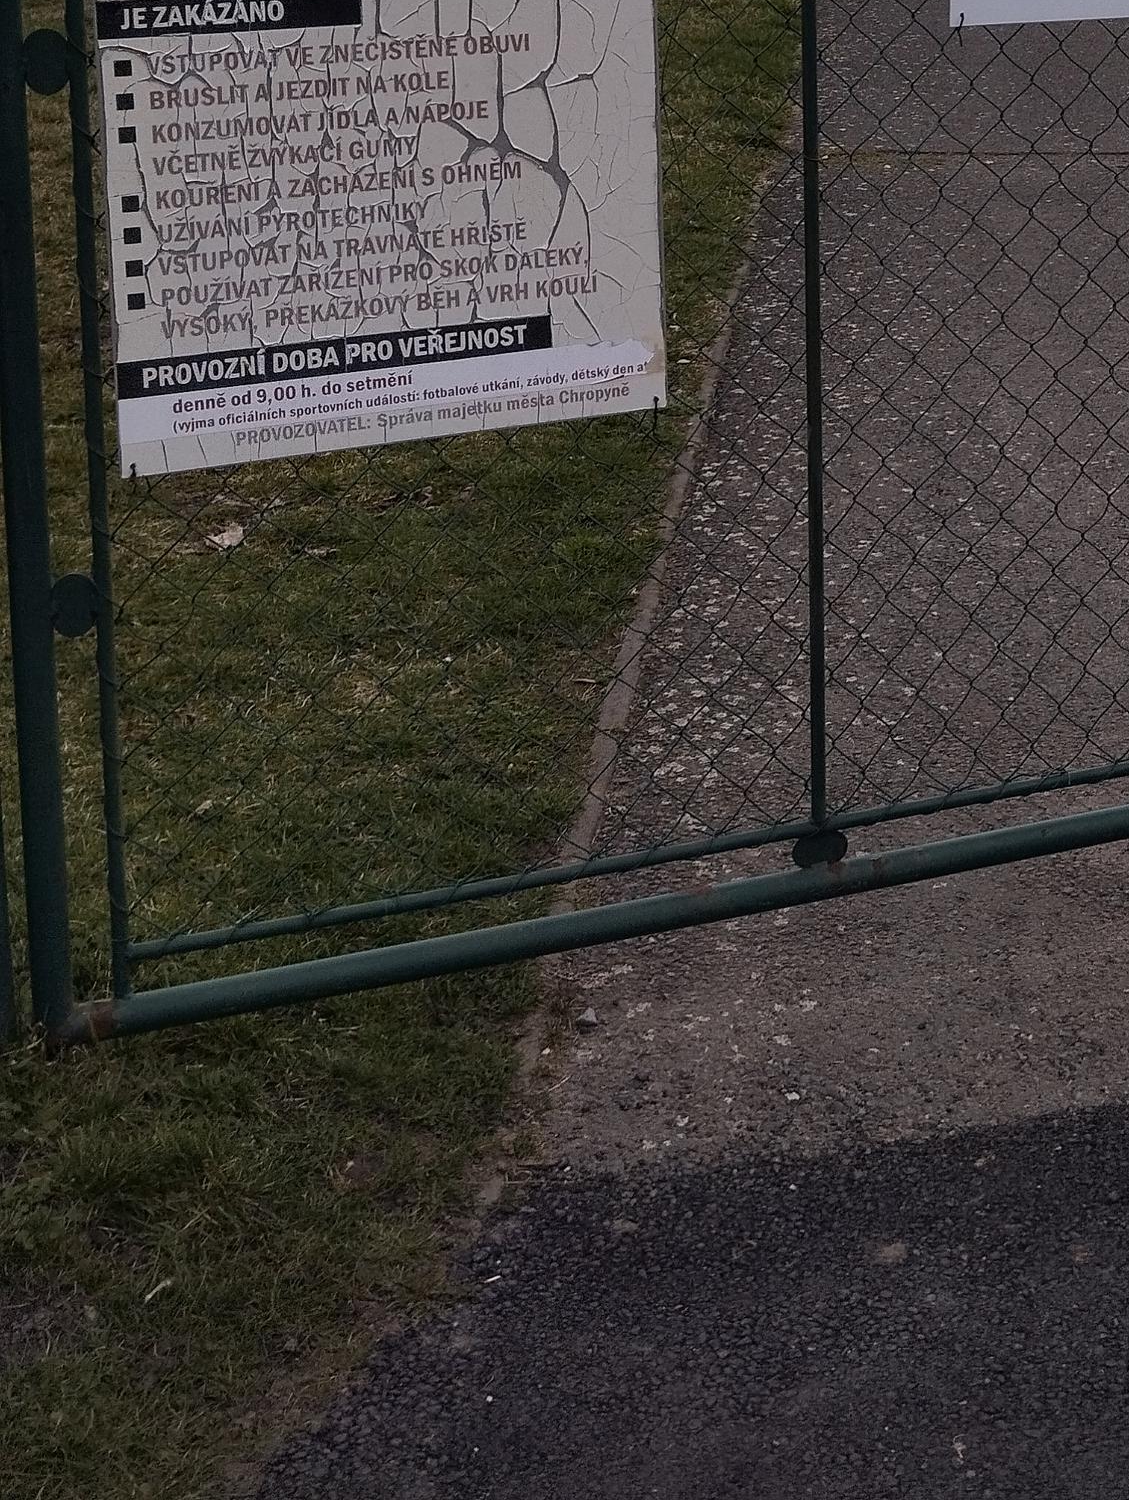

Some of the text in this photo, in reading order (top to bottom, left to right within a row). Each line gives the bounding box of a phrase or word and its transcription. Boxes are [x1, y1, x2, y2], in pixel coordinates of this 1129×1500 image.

[121, 7, 147, 30] JE
[149, 33, 530, 75] VSTUPOVAT VE ZNEČIŠTĚNÉ OBUVI
[150, 71, 449, 110] BRUSLIT A JEZDIT NA KOLE
[152, 113, 312, 144] KONZUMOVAT
[385, 107, 399, 125] A
[407, 99, 489, 125] NÁPOJE
[152, 136, 416, 176] VČETNĚ ŽVÝKACÍ GUMY
[267, 181, 282, 199] A
[421, 168, 434, 186] S
[441, 158, 522, 185] OHNĚM
[157, 201, 429, 244] UŽÍVÁNÍ PYROTECHNIKY
[158, 216, 527, 276] VSTUPOVAT NA TRAVNATÉ HŘIŠTĚ
[162, 241, 588, 306] POUŽÍVAT ZAŘÍZENÍ PRO SKOK DALEKÝ,
[161, 306, 257, 340] VYSOKÝ,
[416, 287, 459, 311] BĚH
[466, 288, 481, 305] A
[487, 283, 528, 303] VRH
[536, 269, 597, 298] KOULÍ
[142, 324, 527, 389] PROVOZNÍ DOBA PRO VEŘEJNOST
[172, 369, 412, 413] denně od 9,00 h. do setmění
[173, 416, 215, 434] (vyjma
[219, 408, 286, 426] oficiálních
[290, 398, 363, 421] sportovních
[366, 389, 420, 409] událostí:
[423, 382, 479, 400] fotbalové
[482, 377, 524, 394] utkání,
[527, 372, 569, 389] závody,
[571, 362, 610, 381] dětský
[612, 363, 635, 375] den
[236, 382, 630, 446] PROVOZOVATEL: Správa majetku města Chropyně
